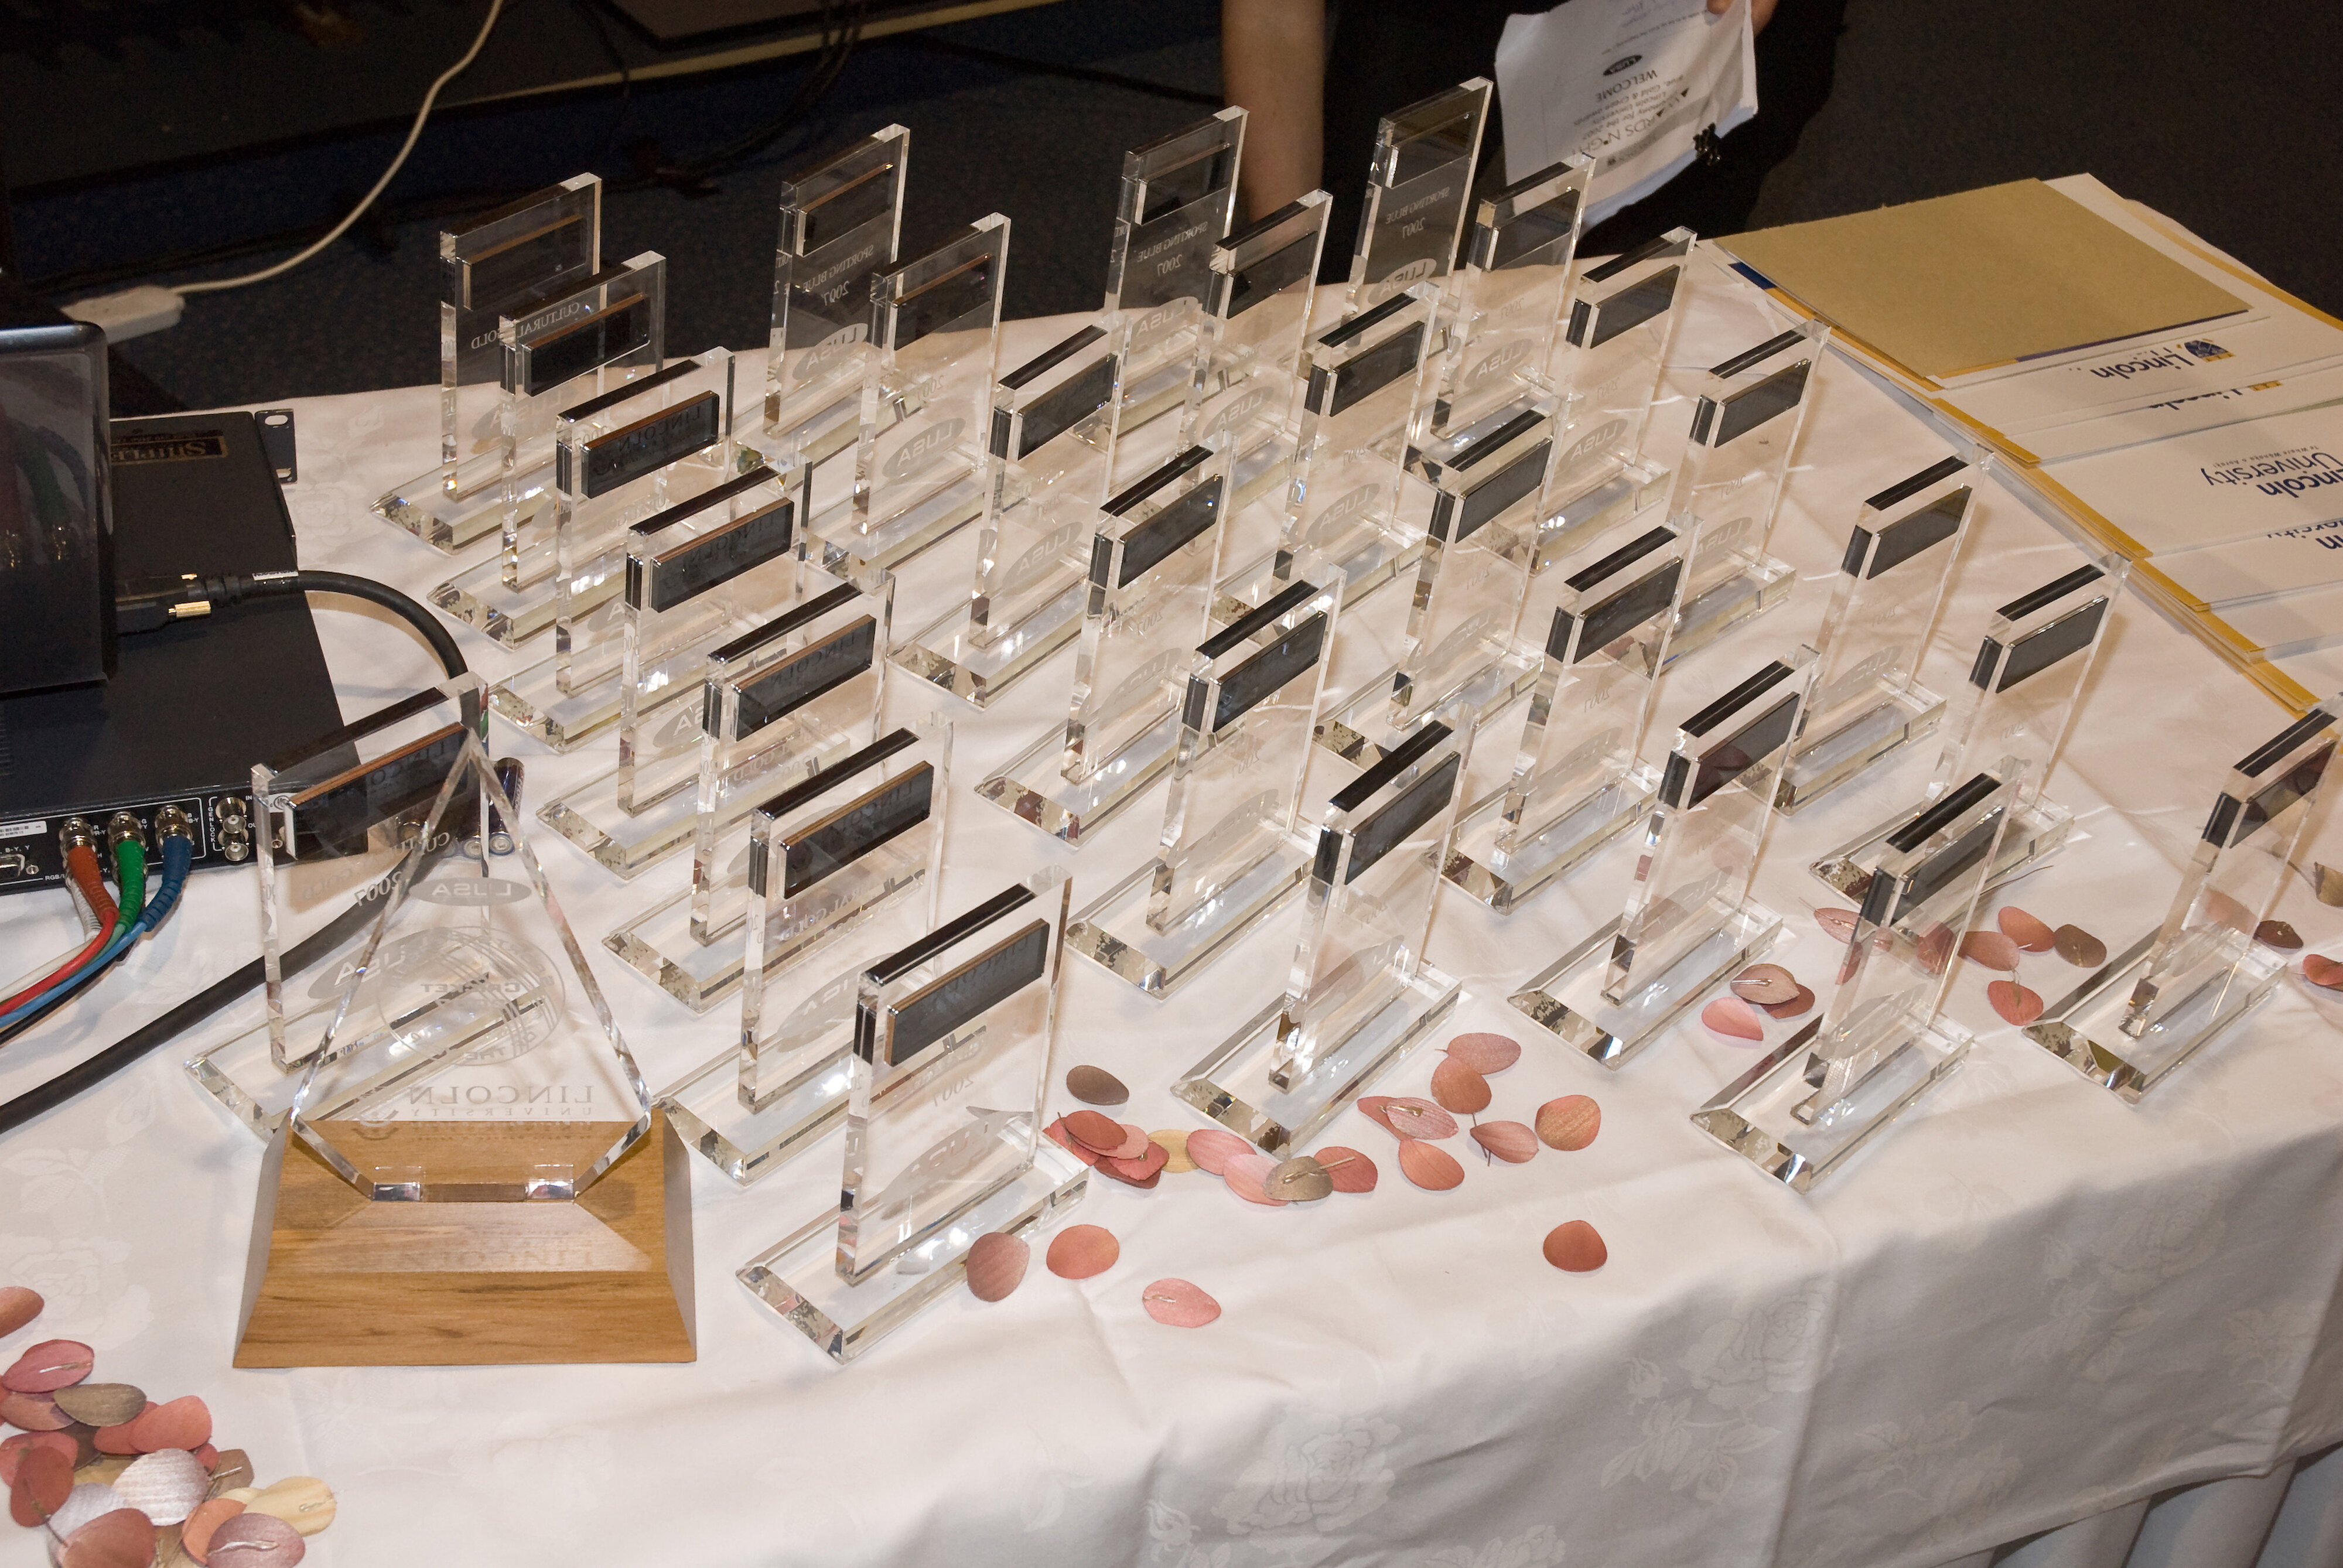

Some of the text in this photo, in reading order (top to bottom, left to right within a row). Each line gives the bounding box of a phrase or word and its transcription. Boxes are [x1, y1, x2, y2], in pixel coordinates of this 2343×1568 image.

[1595, 69, 1658, 103] WELCOME
[2090, 353, 2195, 380] Lincoln
[2200, 452, 2343, 486] University
